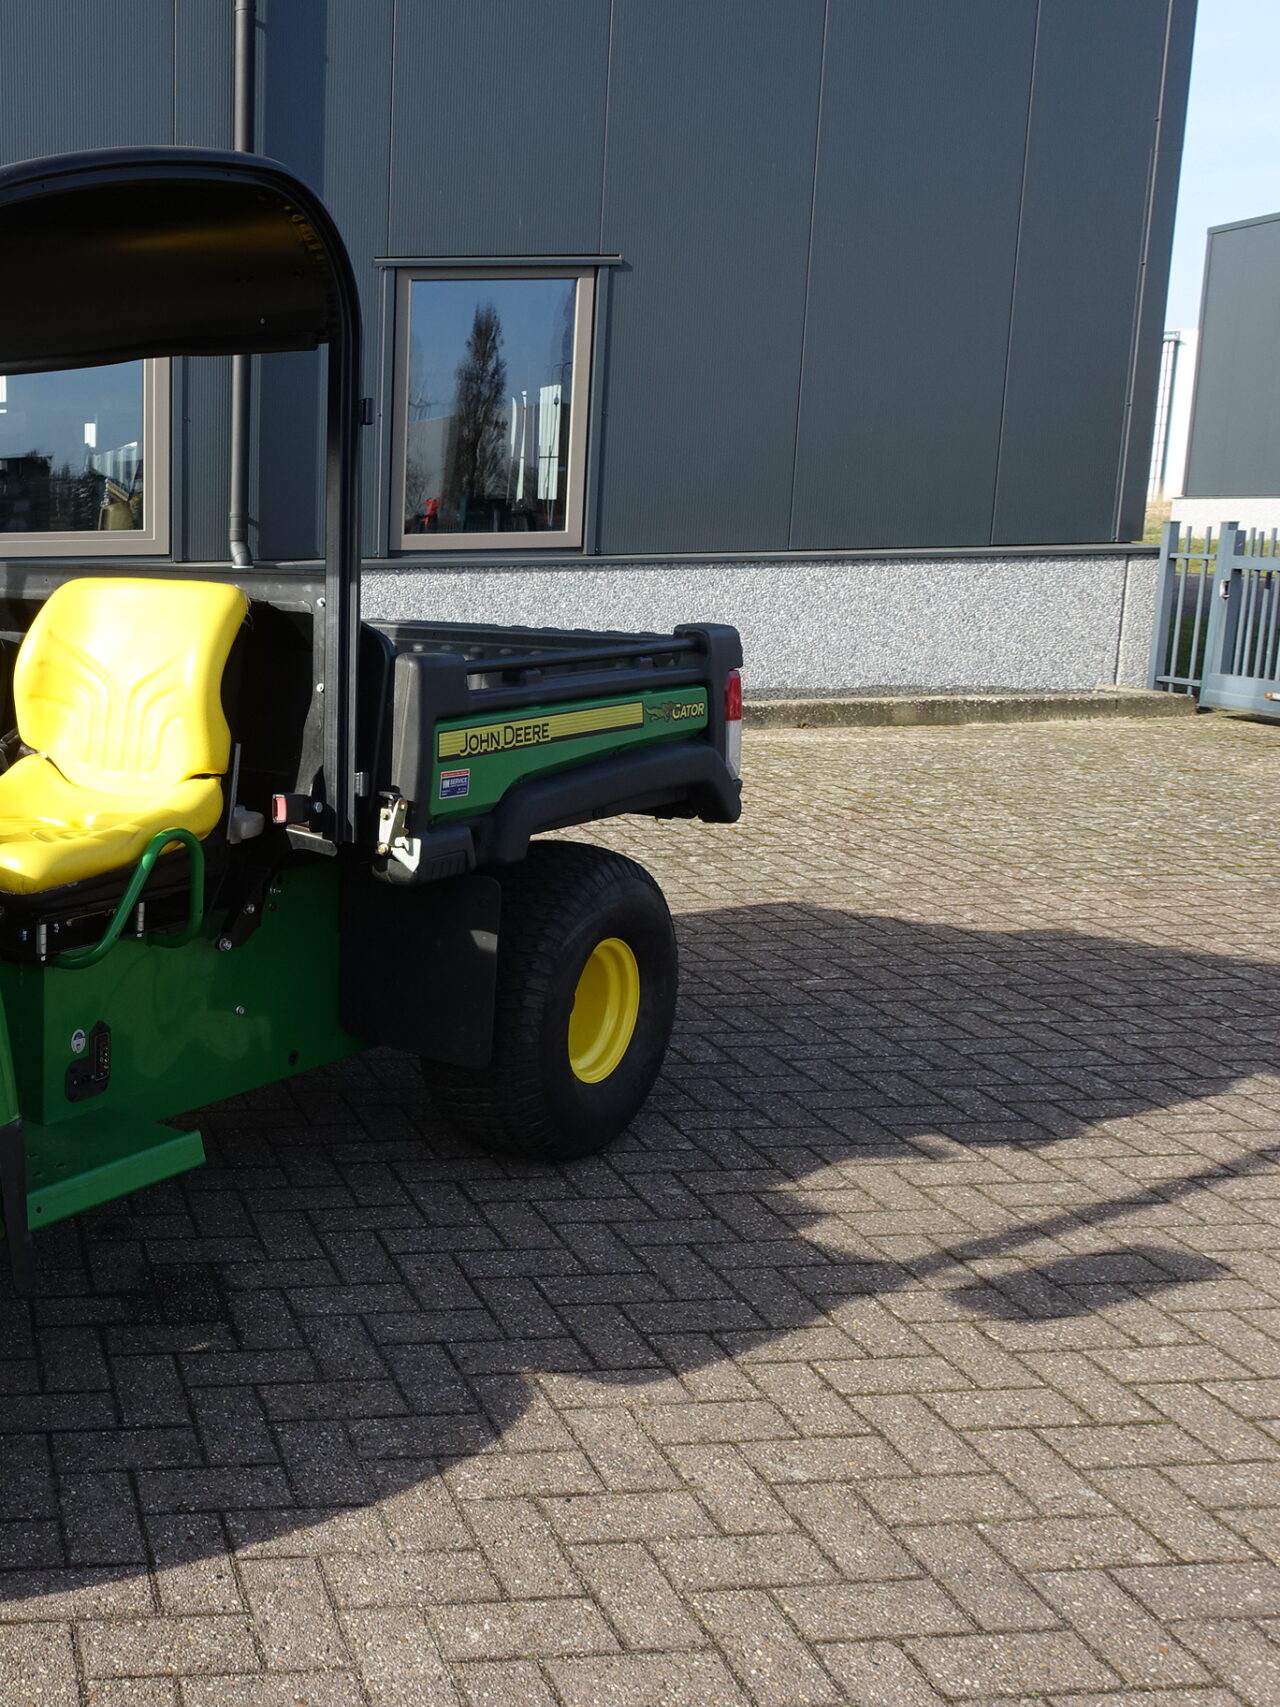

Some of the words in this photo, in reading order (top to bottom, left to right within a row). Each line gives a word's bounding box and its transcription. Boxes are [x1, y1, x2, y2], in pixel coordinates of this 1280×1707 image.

[672, 702, 705, 719] GATOR
[460, 731, 500, 753] JOHN
[504, 723, 549, 746] DEERE
